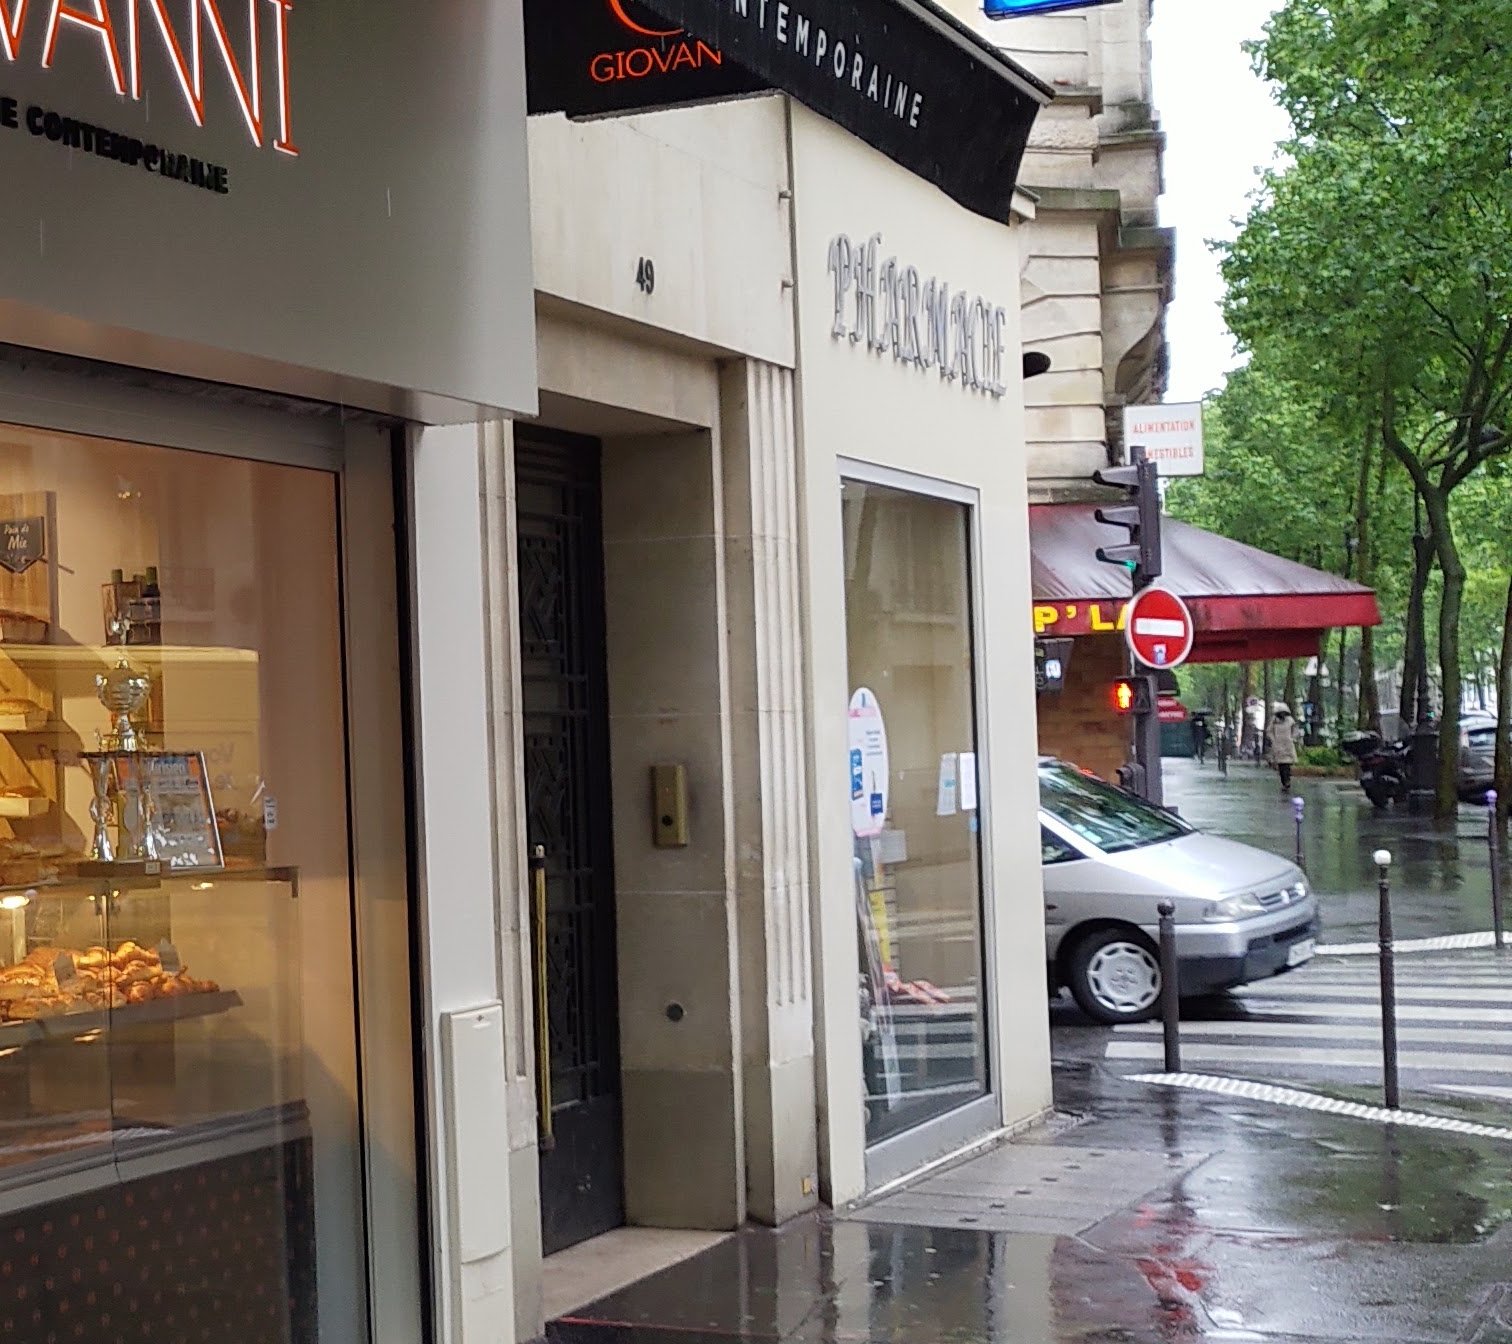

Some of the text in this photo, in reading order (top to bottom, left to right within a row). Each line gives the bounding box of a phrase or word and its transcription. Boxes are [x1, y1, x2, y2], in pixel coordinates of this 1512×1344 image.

[590, 40, 722, 82] GIOVAN
[636, 256, 655, 295] 49
[827, 232, 1007, 398] PHARMACIE
